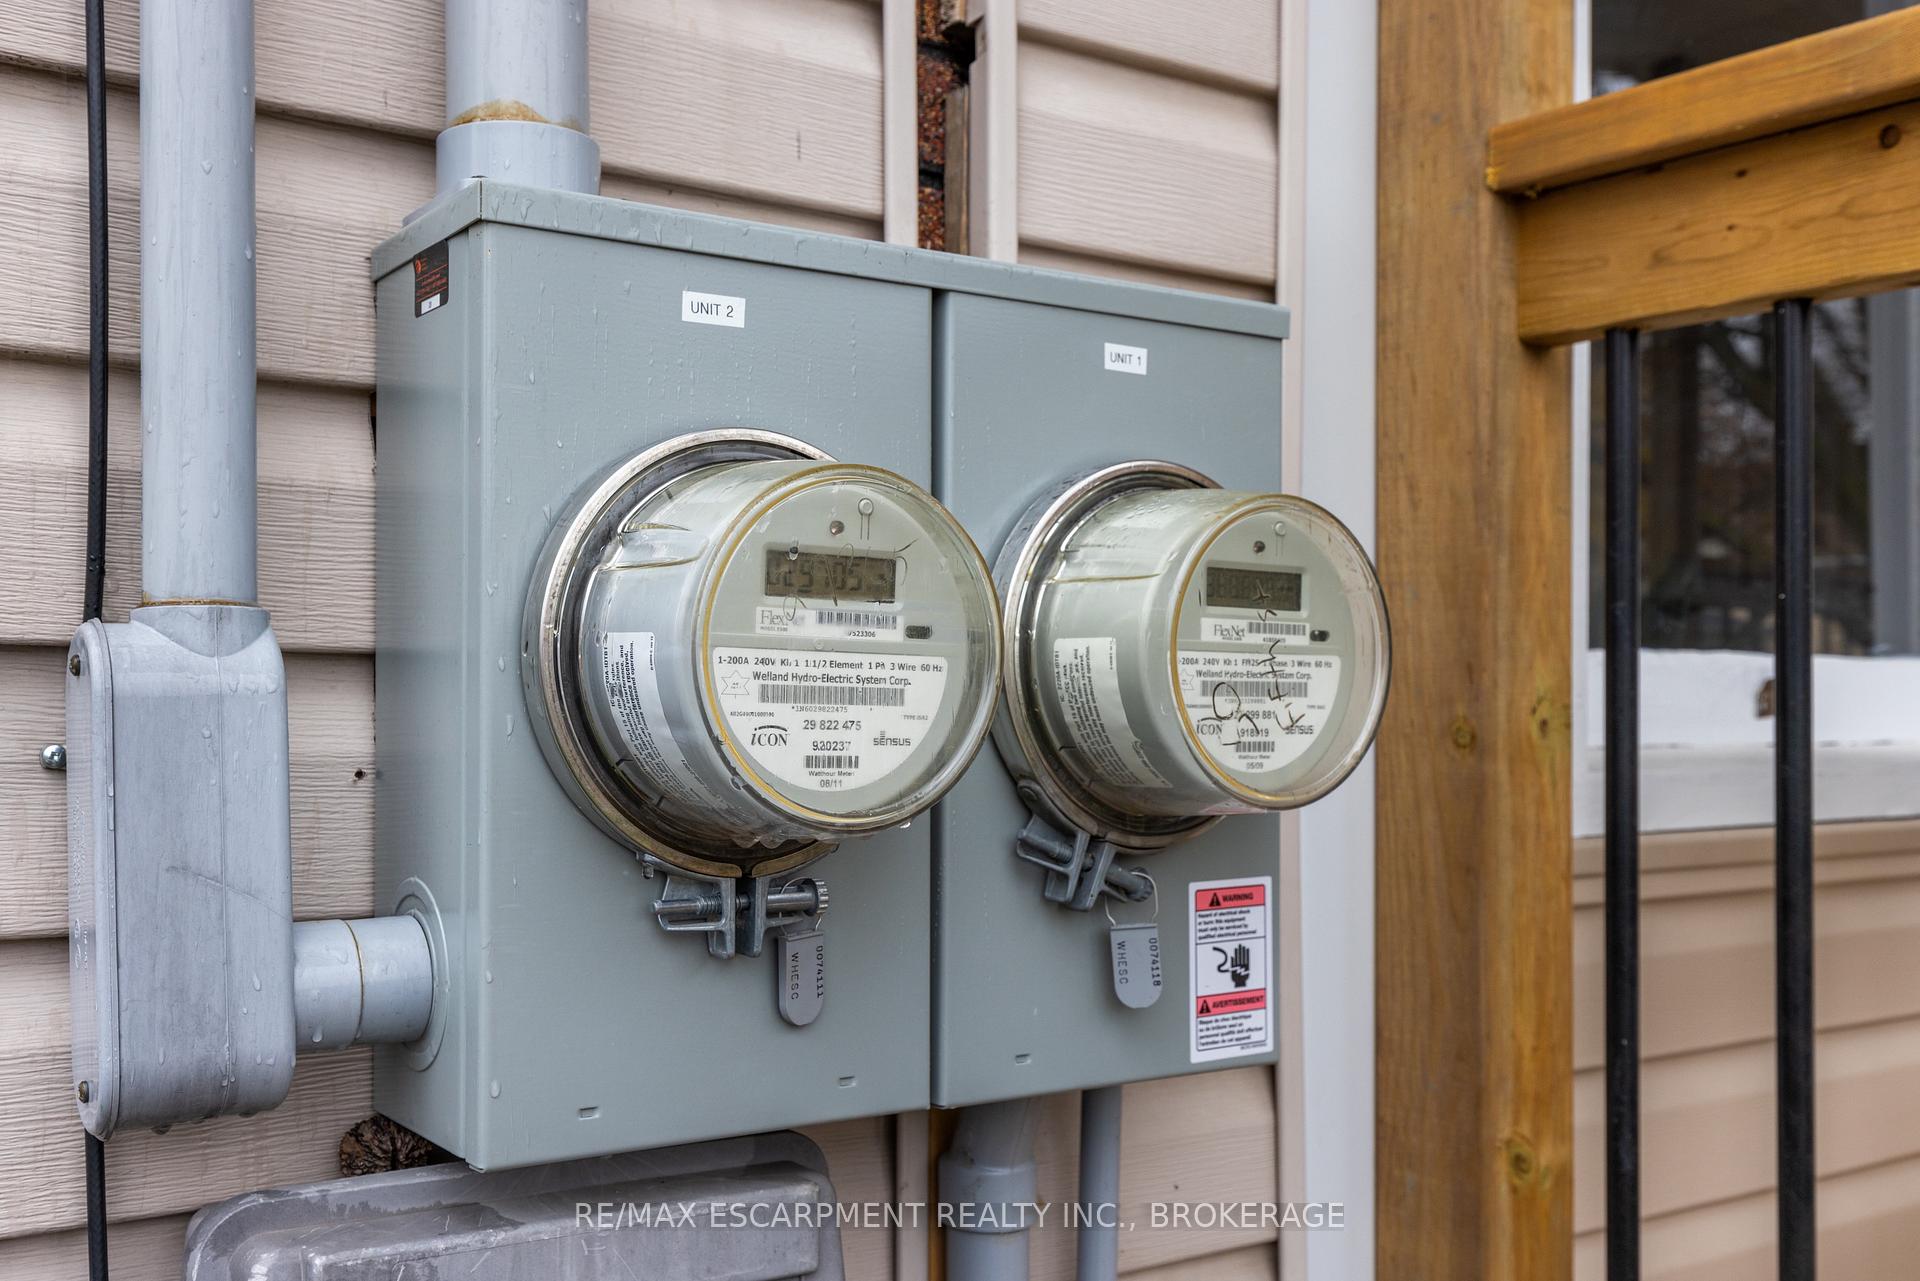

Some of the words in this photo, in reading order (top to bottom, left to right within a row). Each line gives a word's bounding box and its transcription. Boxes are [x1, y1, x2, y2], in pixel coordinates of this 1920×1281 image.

[690, 300, 721, 316] UNIT
[726, 305, 734, 318] 2
[1110, 352, 1132, 364] UNIT
[1137, 356, 1141, 366] 1
[718, 656, 749, 664] 1-200A
[754, 657, 775, 666] 240V
[829, 660, 863, 670] Element
[890, 662, 895, 670] 3
[898, 663, 916, 671] Wire
[920, 664, 930, 672] 60
[932, 664, 942, 672] Hz
[752, 671, 788, 681] Welland
[792, 672, 854, 684] Hydro-Electric
[856, 674, 886, 686] System
[889, 676, 912, 687] Corp.
[1196, 670, 1222, 678] Welland
[1296, 672, 1312, 680] Corp.
[802, 720, 816, 730] 29
[819, 720, 839, 730] 822
[842, 720, 862, 731] 475
[1222, 892, 1254, 903] WARNING
[1116, 940, 1129, 985] WHESC
[1148, 937, 1162, 986] 0074118
[790, 952, 800, 1000] WHESC
[816, 945, 824, 998] 0074111
